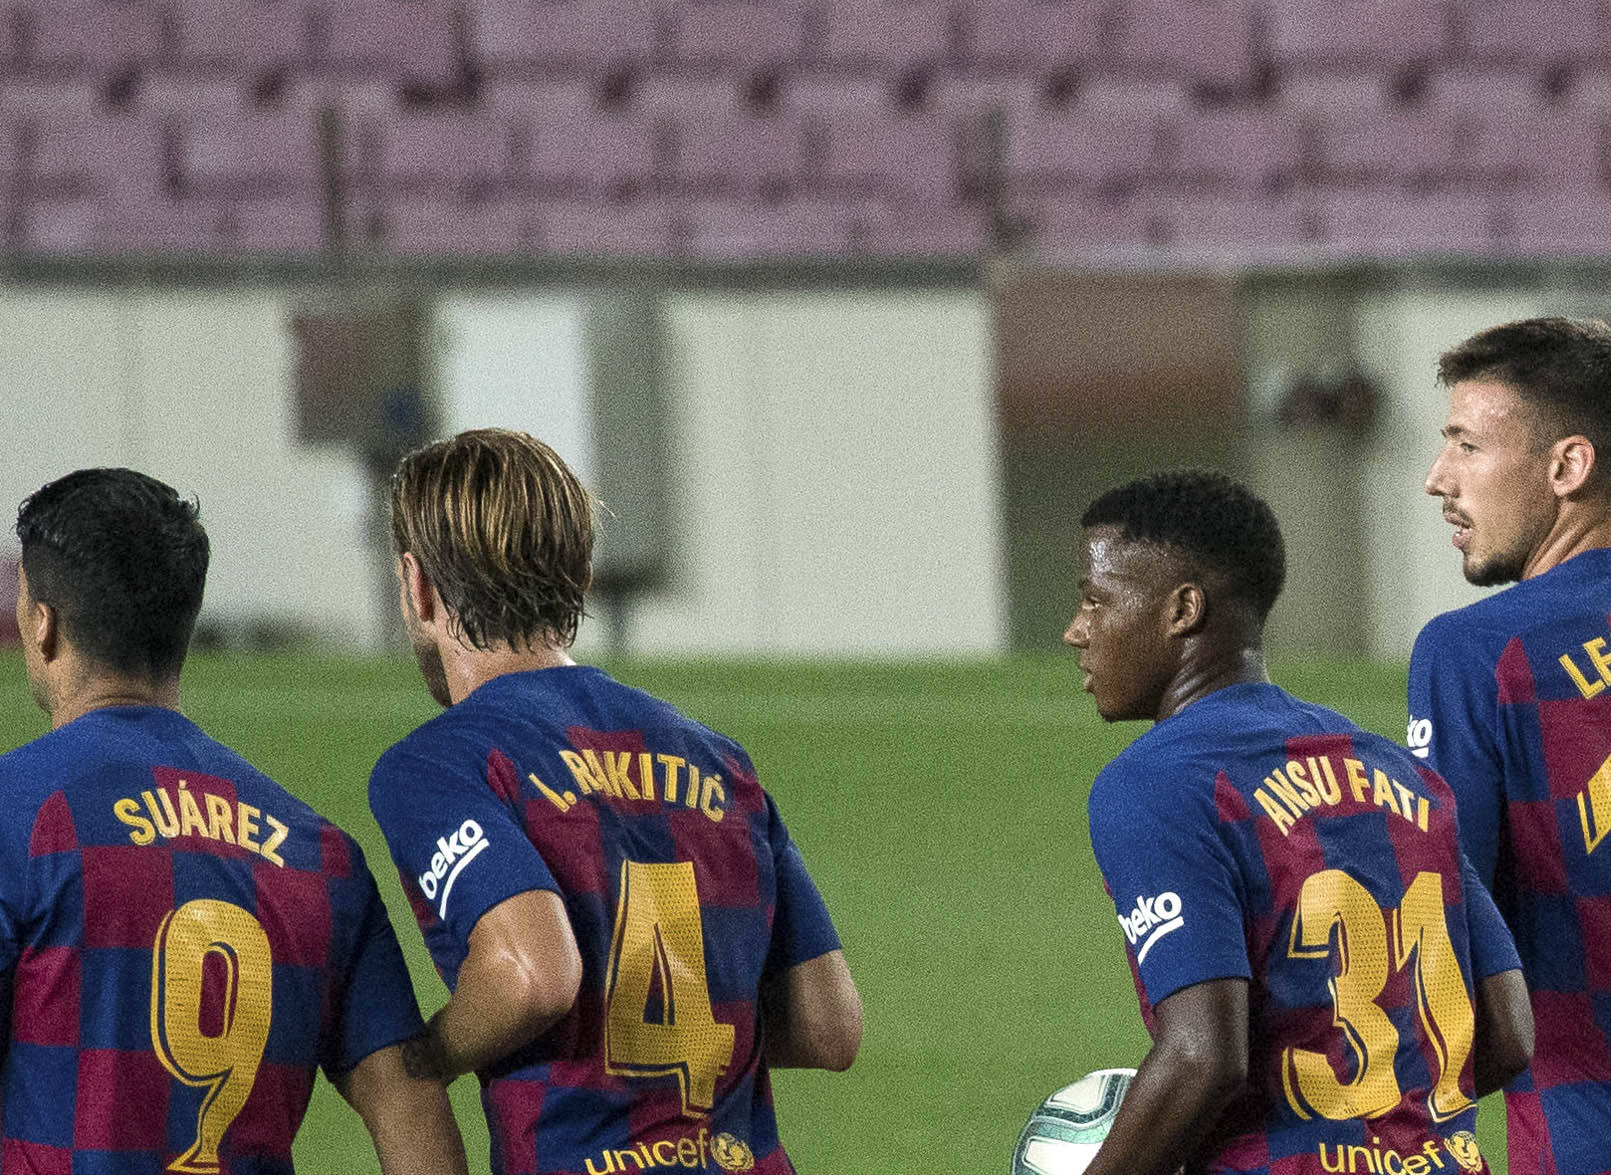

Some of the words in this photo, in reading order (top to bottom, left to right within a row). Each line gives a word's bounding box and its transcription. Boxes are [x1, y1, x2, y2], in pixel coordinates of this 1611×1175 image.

[113, 779, 290, 868] SUÁREZ
[528, 772, 578, 813] I.
[1253, 756, 1342, 837] ANSU
[1343, 757, 1431, 833] FATI
[418, 819, 484, 900] beko
[1117, 891, 1182, 944] beko
[605, 860, 736, 1119] 4
[1282, 869, 1478, 1123] 31
[151, 898, 273, 1174] 9
